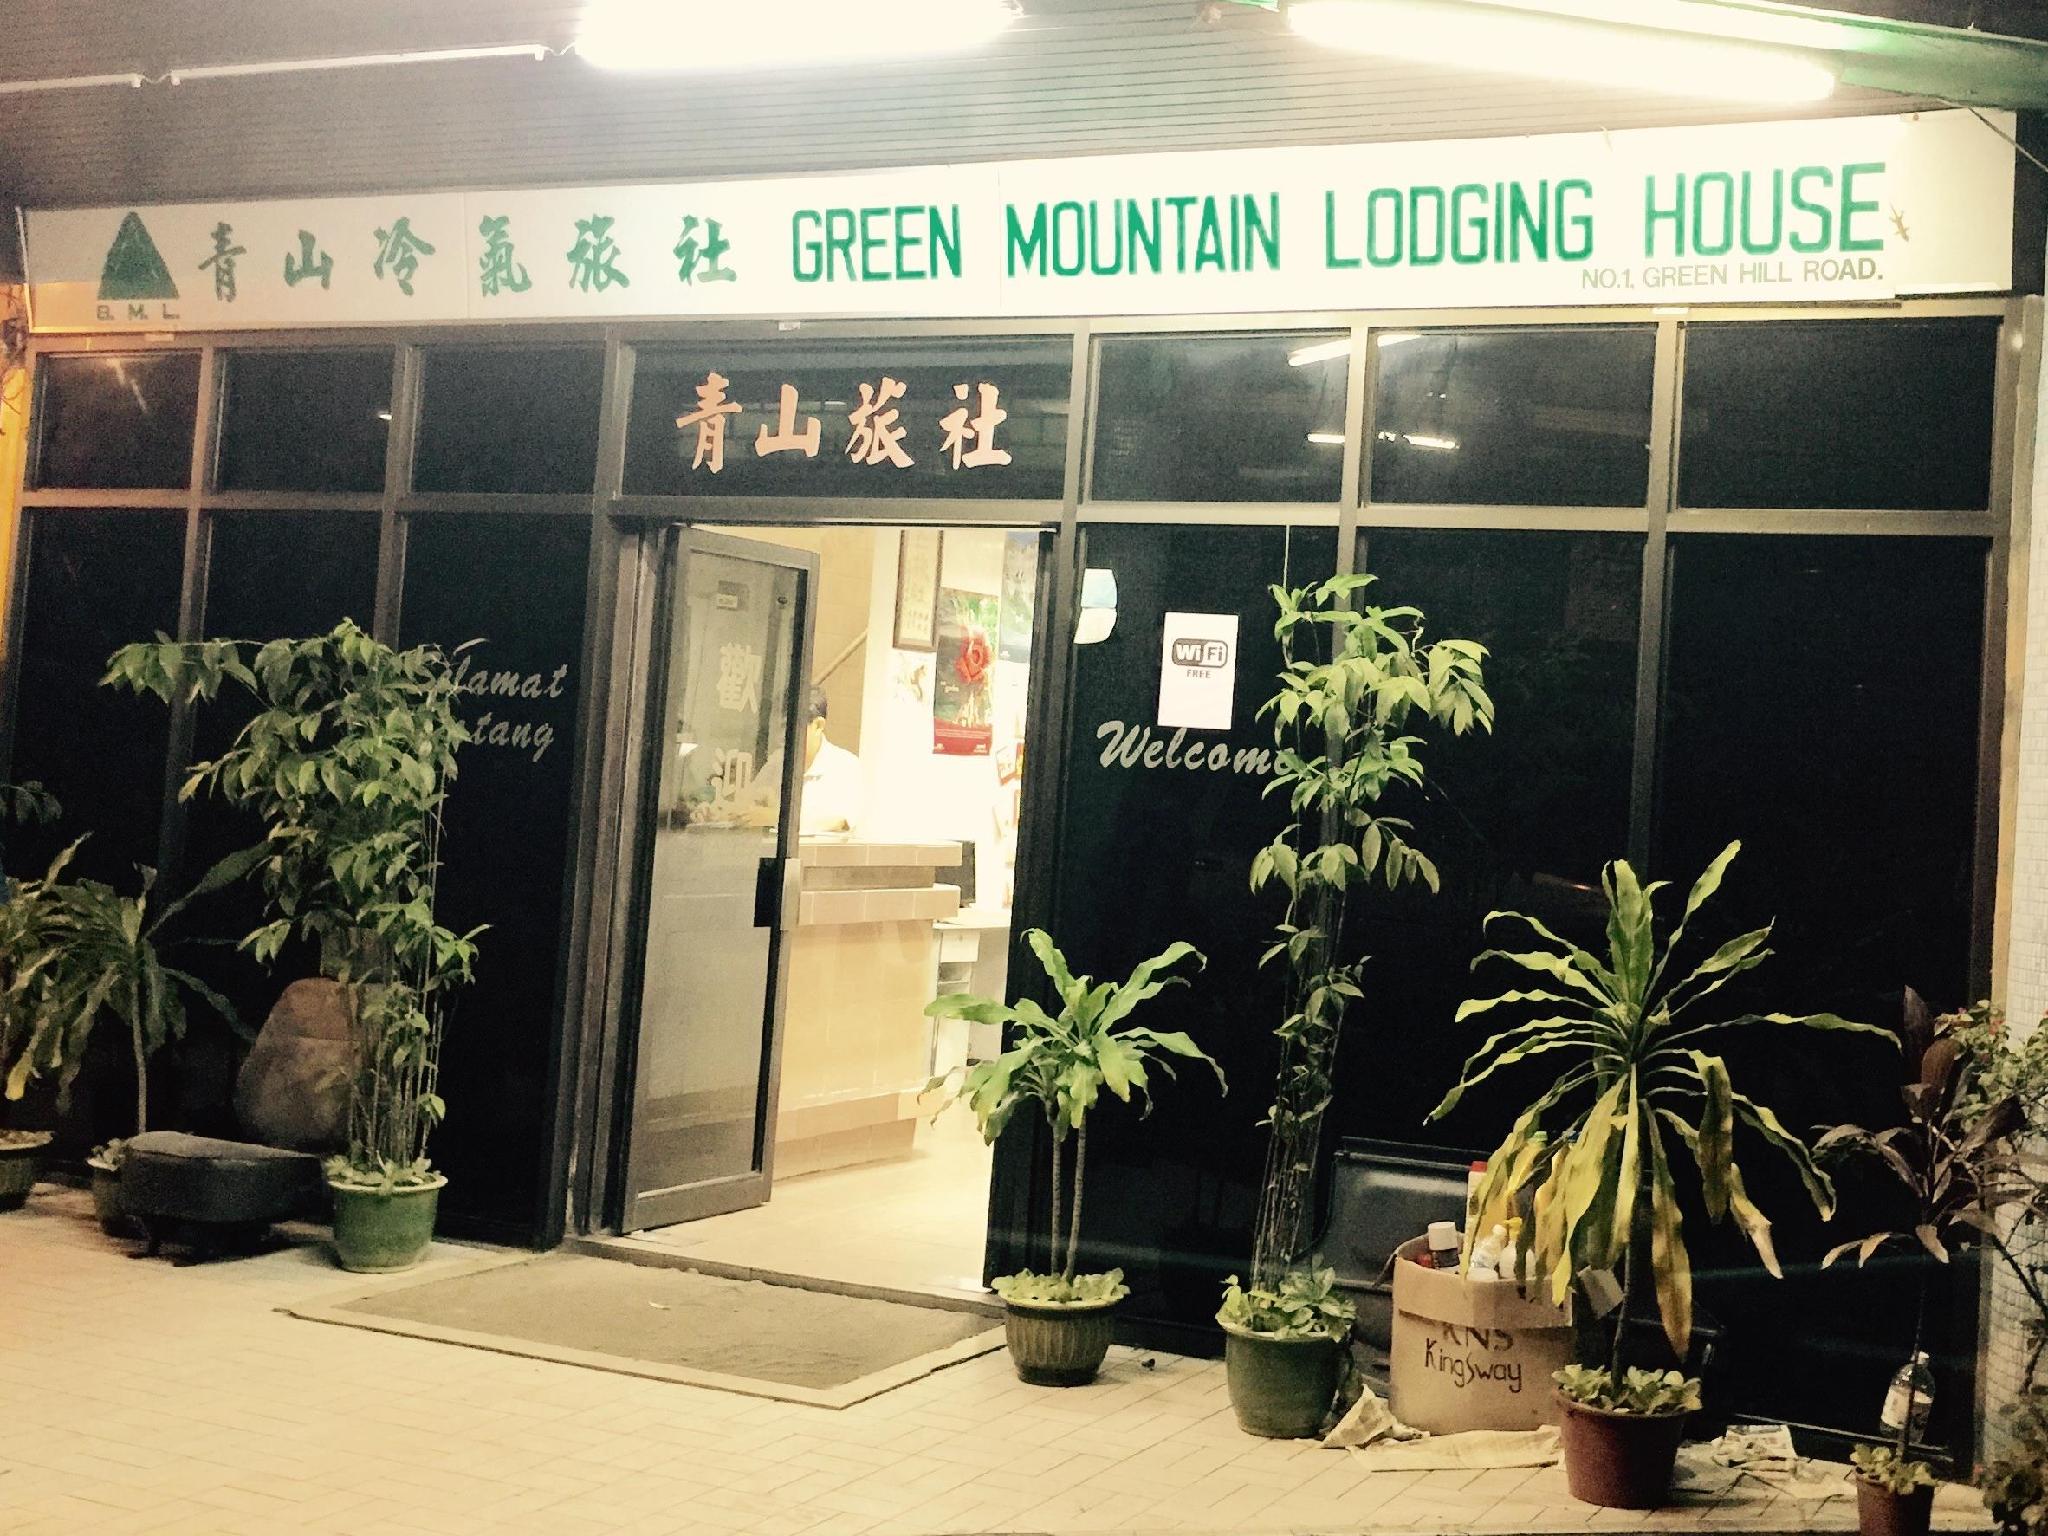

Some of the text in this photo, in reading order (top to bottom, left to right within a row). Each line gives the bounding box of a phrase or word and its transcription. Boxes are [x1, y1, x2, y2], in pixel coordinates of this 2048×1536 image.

[791, 162, 1886, 283] GREEN MOUNTAIN LODGING HOUSE
[198, 213, 738, 303] 青山冷氣旅社
[1642, 264, 1727, 288] GREEN
[1739, 261, 1792, 284] HILL
[1803, 257, 1884, 282] ROAD.
[676, 372, 1013, 474] 青山旅社
[444, 653, 568, 698] lamat
[1186, 669, 1212, 679] FREE
